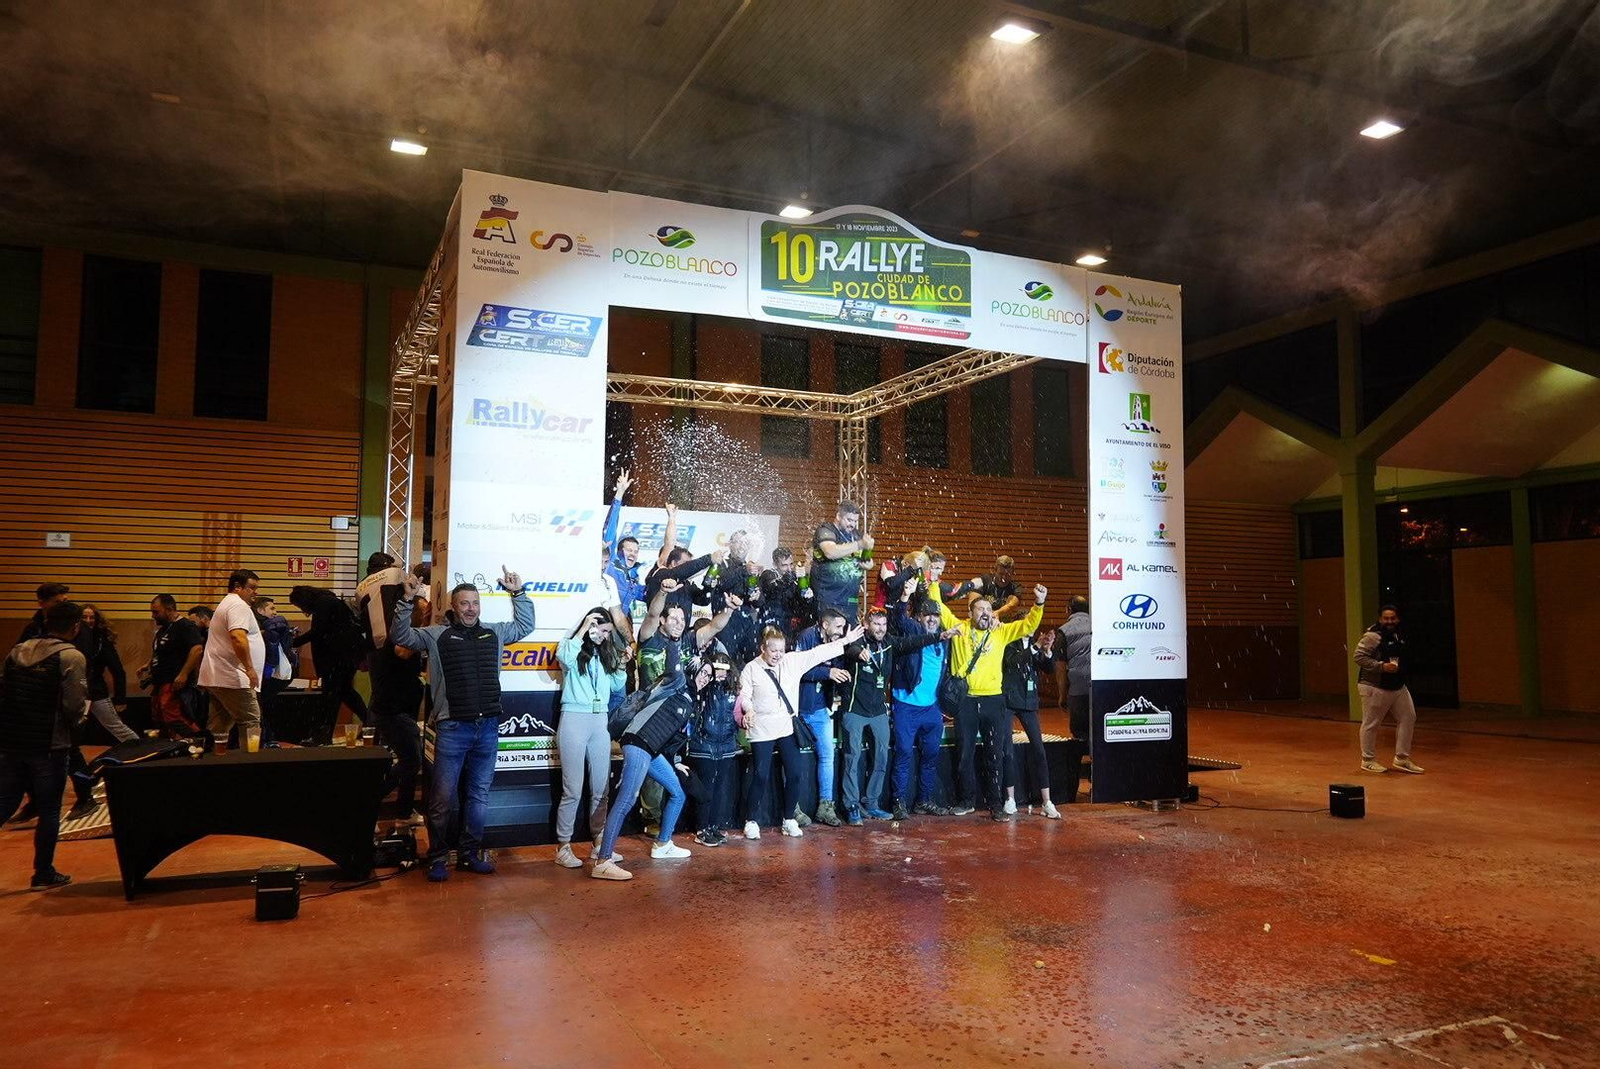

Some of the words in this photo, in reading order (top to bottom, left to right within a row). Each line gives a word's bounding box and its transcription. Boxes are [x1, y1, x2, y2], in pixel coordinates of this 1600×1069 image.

[853, 224, 885, 232] NOVIEMBRE
[612, 248, 738, 277] POZOBLANCO
[771, 231, 814, 283] 10
[819, 241, 925, 273] RALLYE
[471, 263, 520, 275] Automovilismo
[877, 273, 914, 284] CIUDAD
[918, 274, 930, 285] DE
[833, 281, 963, 301] POZOBLANCO
[991, 300, 1085, 326] POZOBLANCO
[1127, 316, 1157, 325] DEPORTE
[479, 329, 546, 348] CERT
[1128, 353, 1174, 367] Diputación
[1128, 365, 1138, 374] de
[1140, 366, 1175, 378] Córdoba
[473, 398, 593, 433] Rallycar
[1106, 439, 1144, 447] AYUNTAMIENTO
[1126, 564, 1139, 572] AL
[496, 581, 589, 592] CHELIN
[1113, 621, 1165, 630] CORHYUND
[502, 646, 557, 666] ecalv
